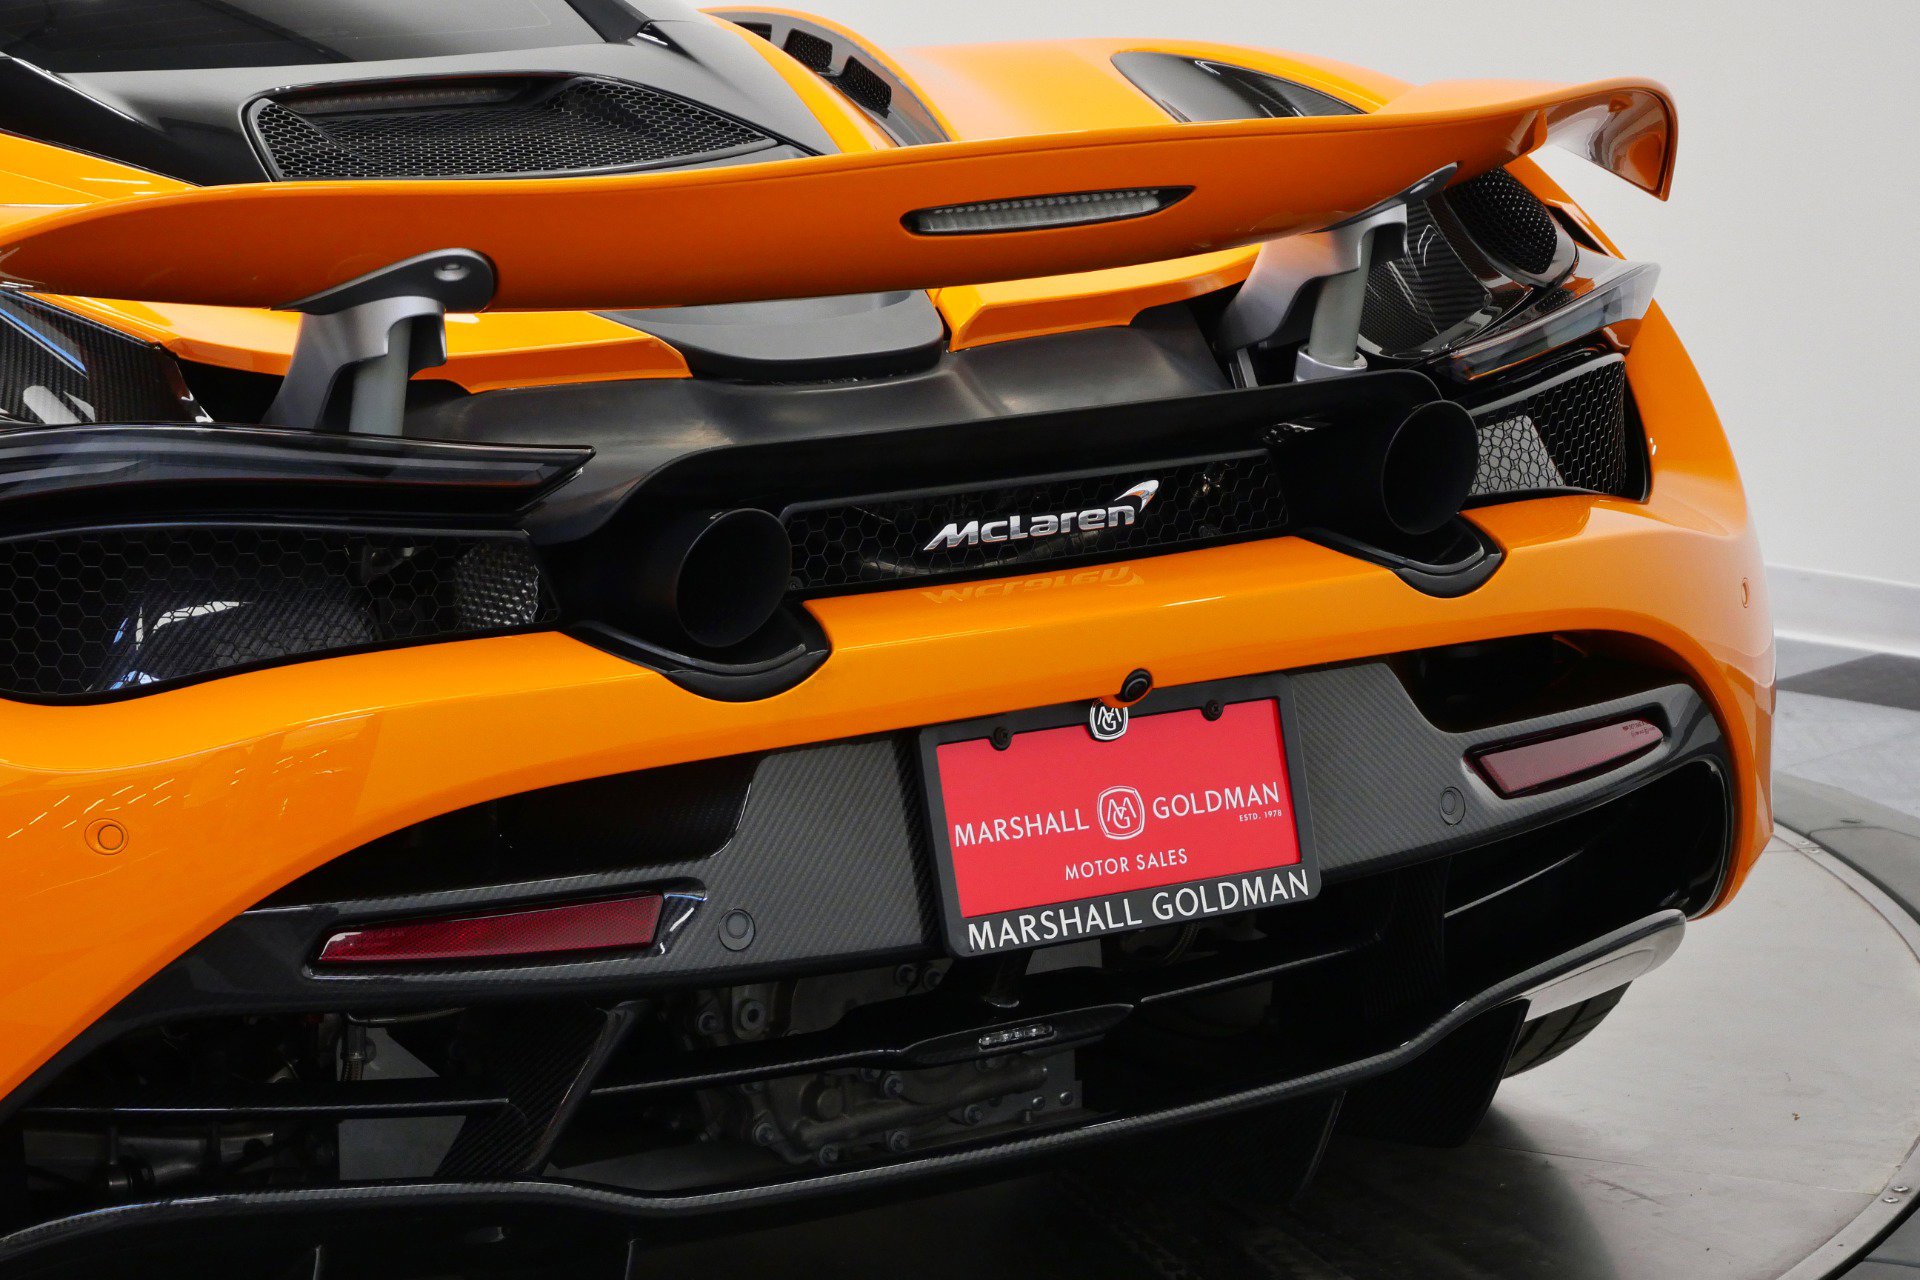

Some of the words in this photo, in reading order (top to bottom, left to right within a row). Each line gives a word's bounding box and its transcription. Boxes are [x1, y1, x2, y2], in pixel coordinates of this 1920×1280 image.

[924, 505, 1135, 550] McLaren
[955, 809, 1090, 847] MARSHALL
[1152, 782, 1280, 819] GOLDMAN
[1239, 812, 1261, 822] ESTD.
[1264, 809, 1282, 818] 1978
[1065, 857, 1130, 881] MOTOR
[1136, 848, 1188, 870] SALES
[968, 899, 1143, 951] MARSHALL
[1151, 869, 1309, 921] GOLDMAN
